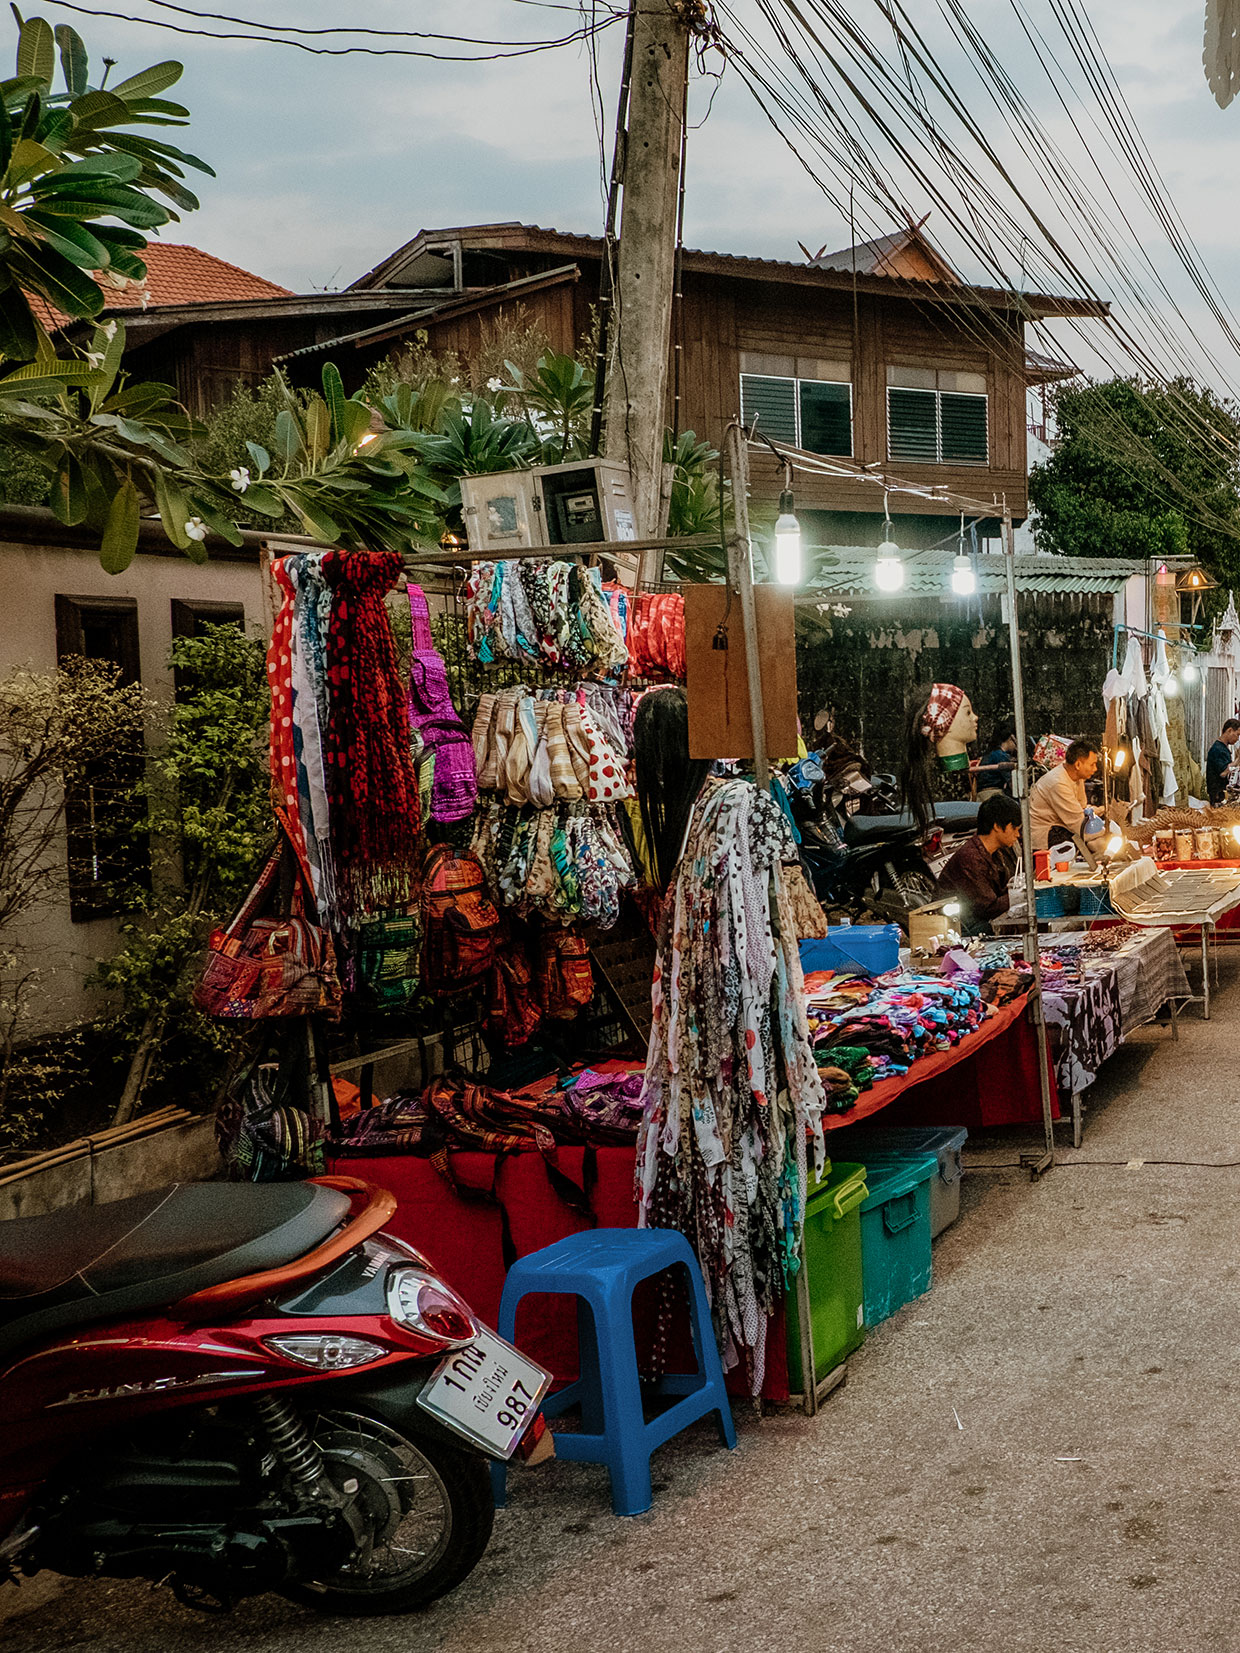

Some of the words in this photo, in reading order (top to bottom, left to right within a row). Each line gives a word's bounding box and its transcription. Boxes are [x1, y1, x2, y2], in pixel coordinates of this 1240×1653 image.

[361, 1251, 391, 1278] YAMAHA
[472, 1361, 509, 1413] เชียงใหม่
[496, 1379, 534, 1431] 987
